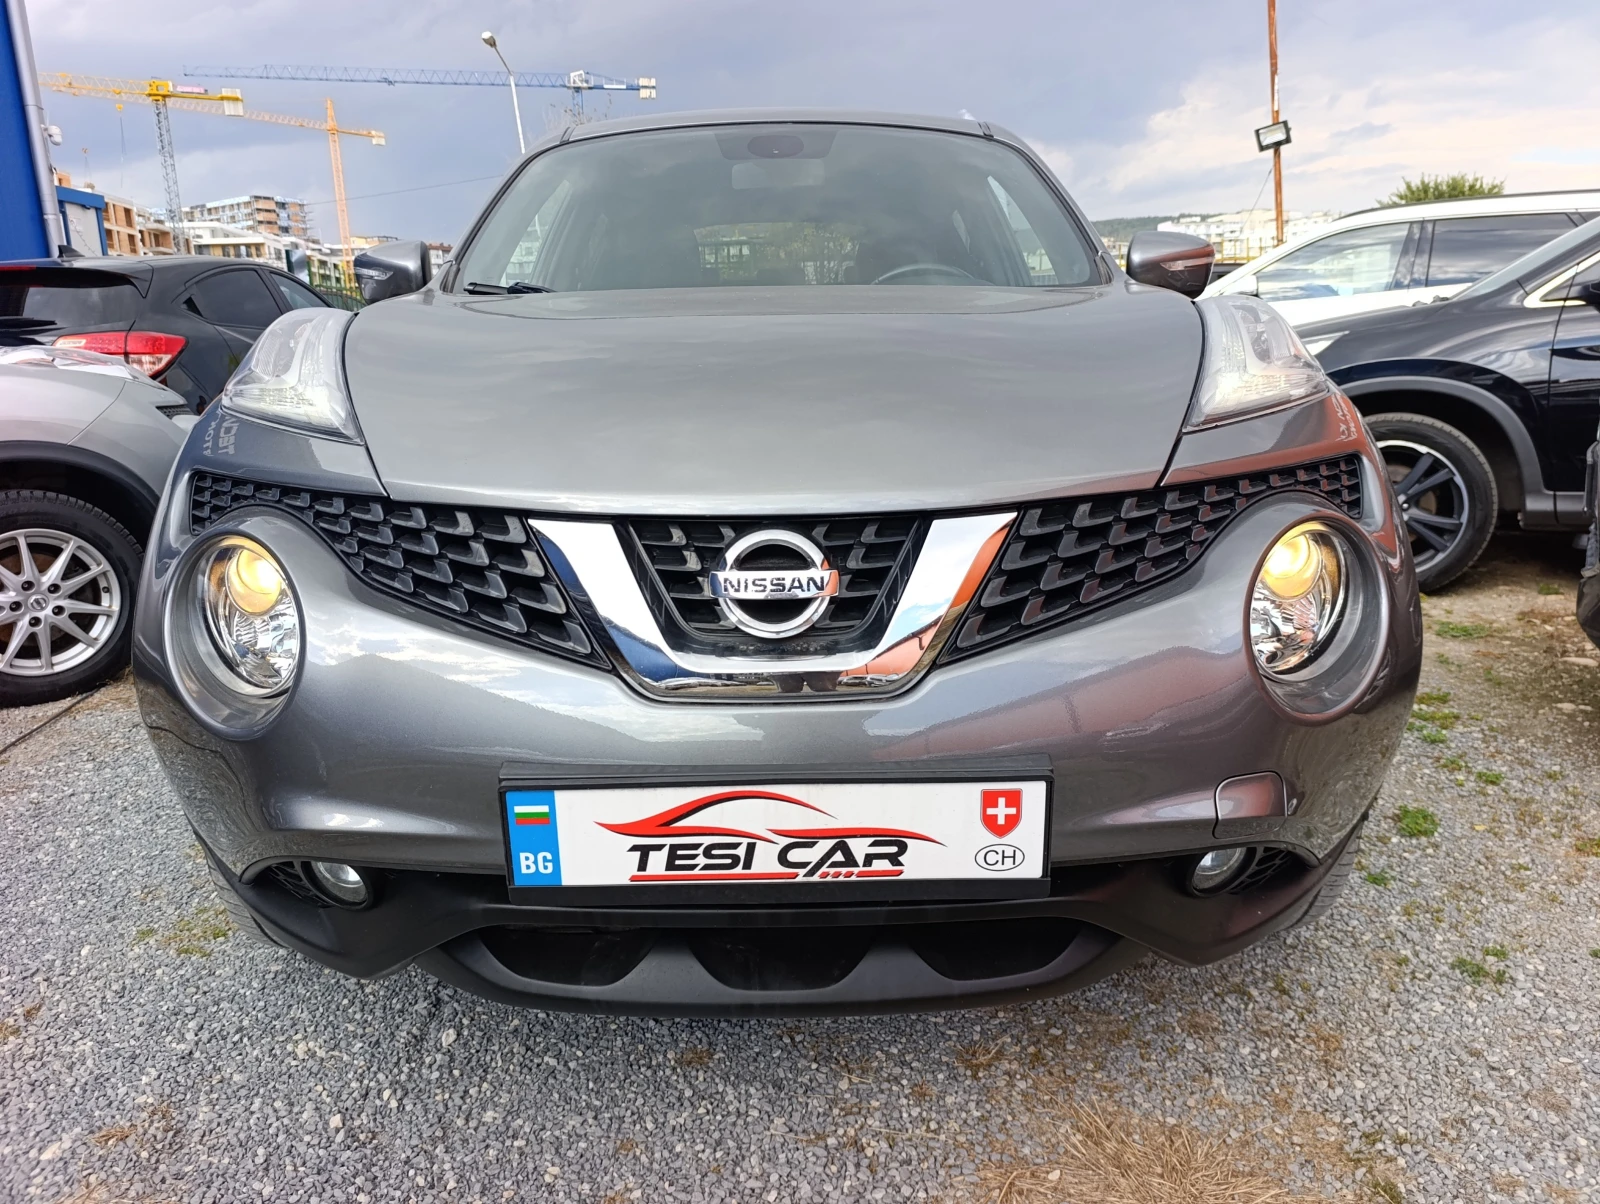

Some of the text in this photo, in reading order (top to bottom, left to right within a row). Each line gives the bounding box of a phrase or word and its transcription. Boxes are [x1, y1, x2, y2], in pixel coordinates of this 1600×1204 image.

[722, 575, 826, 594] NISSAN
[519, 851, 554, 874] BG
[626, 838, 909, 878] TESI CAR
[983, 849, 1016, 866] CH
